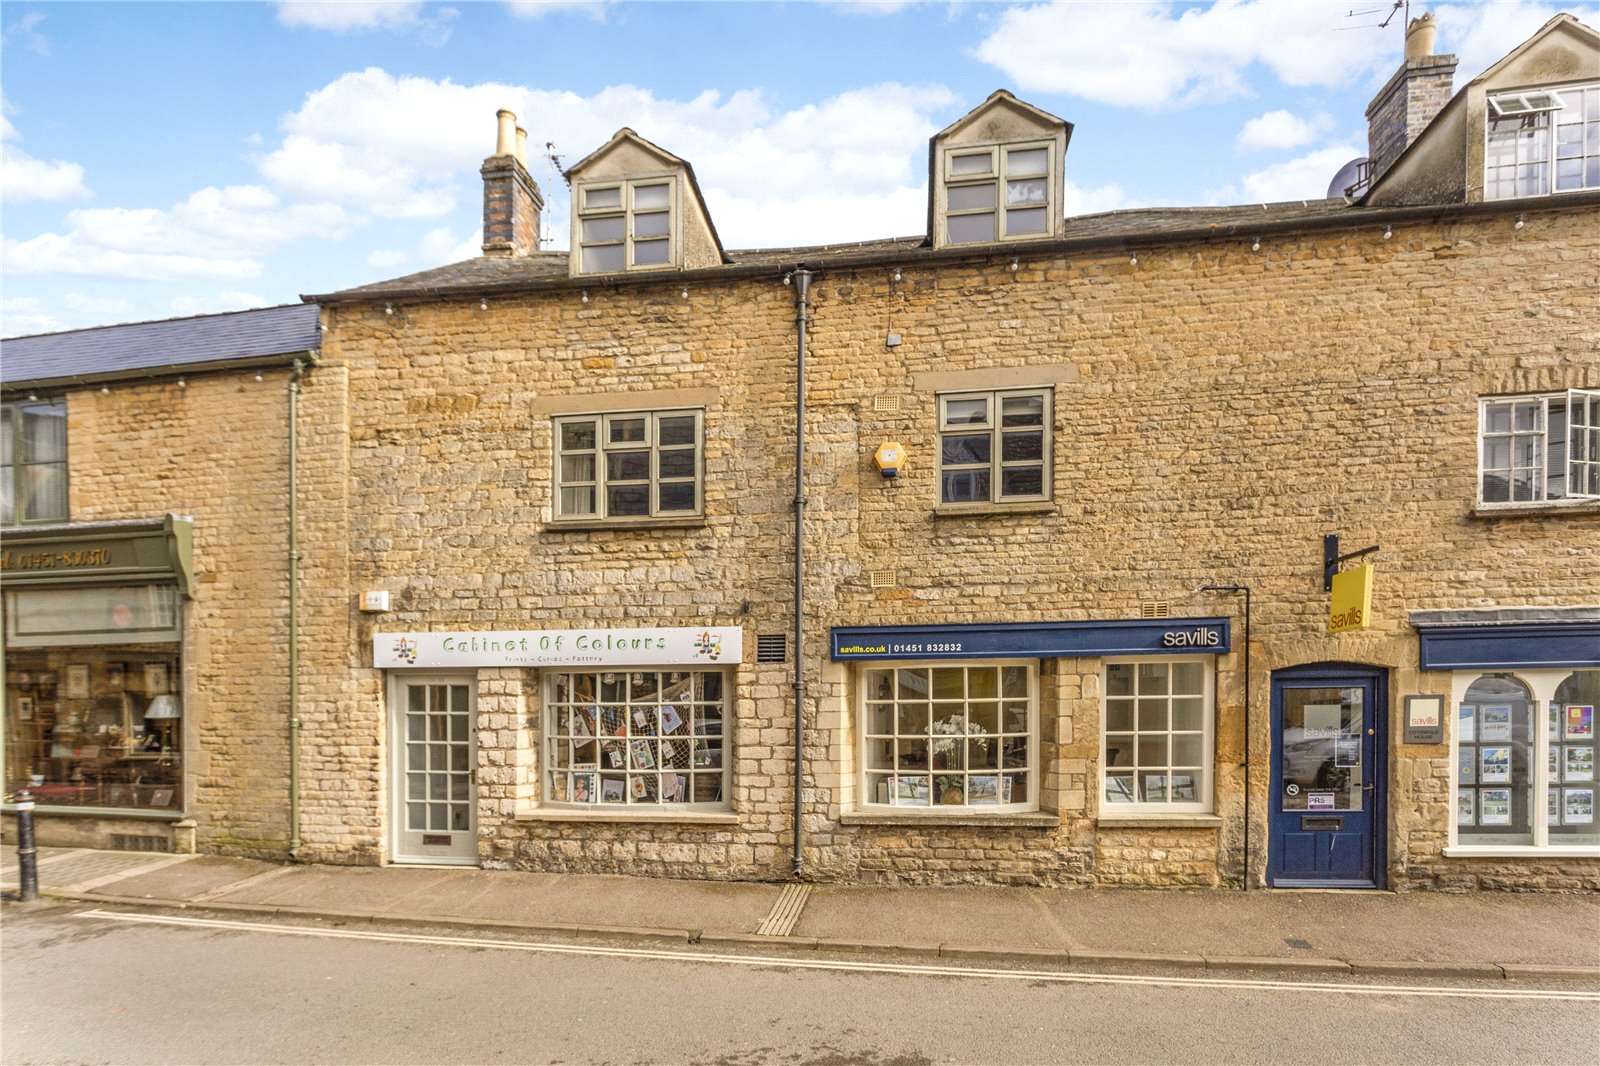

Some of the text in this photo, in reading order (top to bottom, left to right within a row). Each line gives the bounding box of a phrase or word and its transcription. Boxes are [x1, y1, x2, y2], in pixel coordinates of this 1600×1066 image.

[1331, 606, 1362, 629] savills
[443, 634, 665, 652] Cabinet Of Colours
[1163, 627, 1219, 646] savills
[840, 643, 962, 654] savills.co.uk 01451 832832
